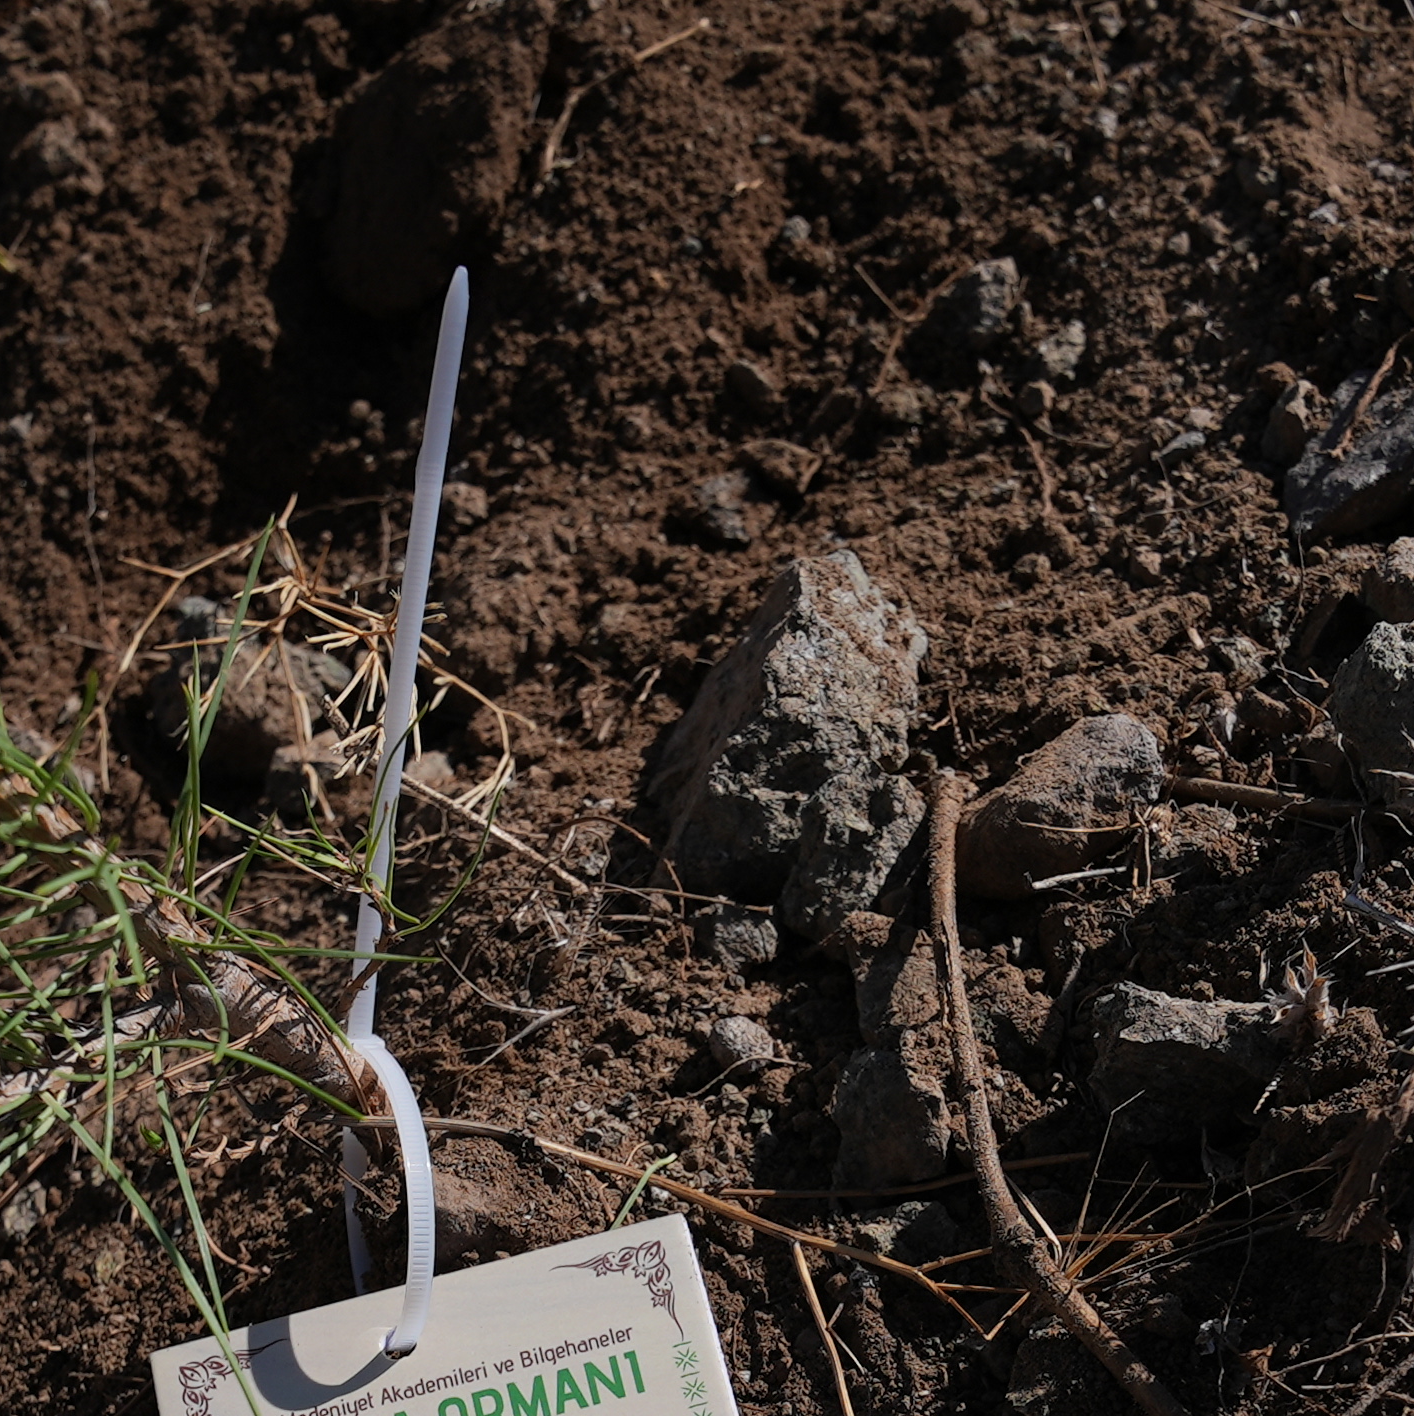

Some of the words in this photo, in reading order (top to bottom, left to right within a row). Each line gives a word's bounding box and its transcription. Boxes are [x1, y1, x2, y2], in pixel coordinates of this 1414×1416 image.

[381, 1361, 488, 1406] Akademileri
[492, 1359, 515, 1375] ve
[519, 1327, 633, 1369] Bilgehaneler
